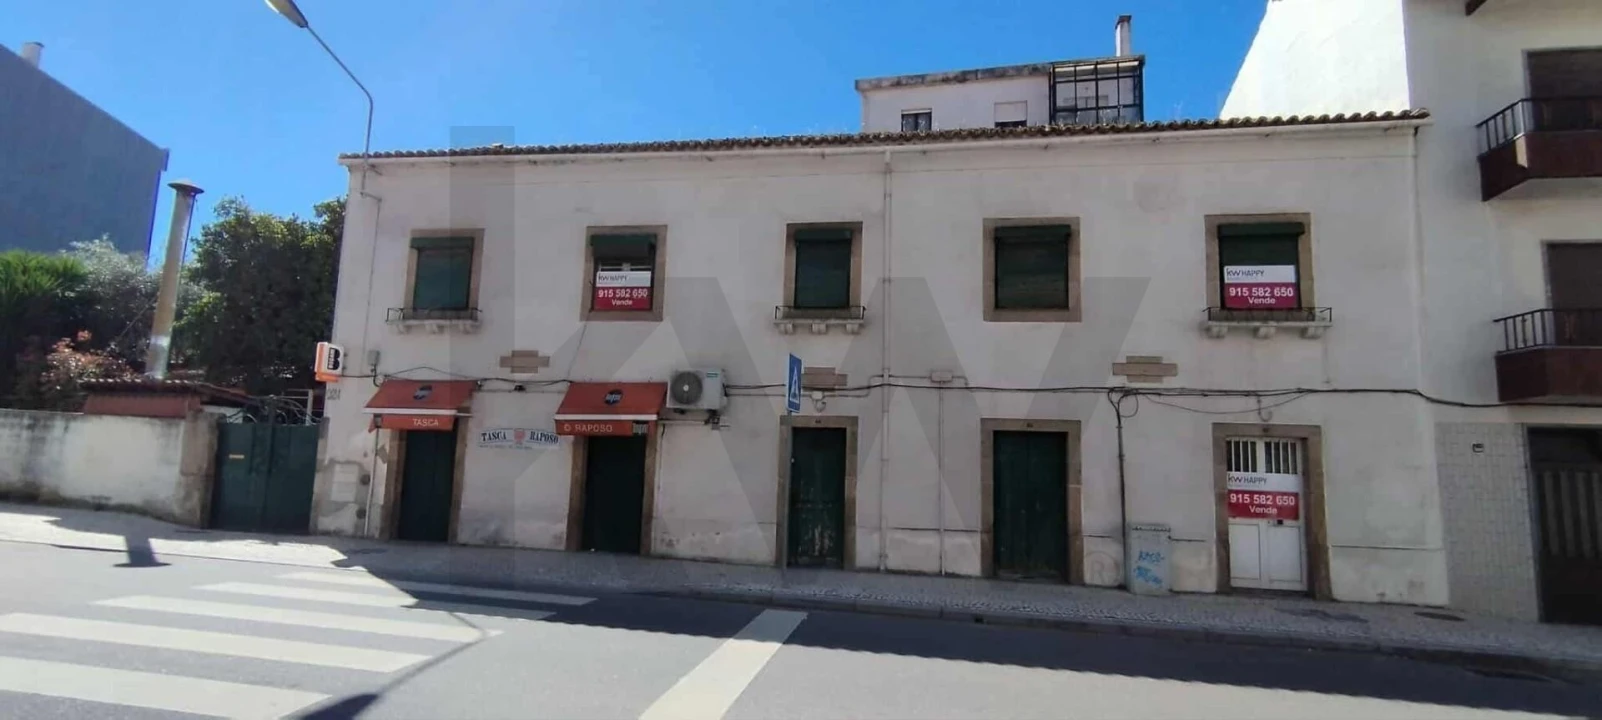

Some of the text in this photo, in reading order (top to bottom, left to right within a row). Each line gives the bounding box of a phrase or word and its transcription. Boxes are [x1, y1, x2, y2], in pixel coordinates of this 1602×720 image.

[598, 288, 648, 298] 915 582 650
[1229, 287, 1294, 297] 915 582 650
[1247, 296, 1276, 304] Vende
[412, 418, 439, 427] TASCA
[575, 424, 613, 433] RAPOSO
[481, 431, 559, 444] TASCA RAPOSO
[1230, 493, 1296, 506] 915 582 650
[1249, 505, 1278, 515] Vende
